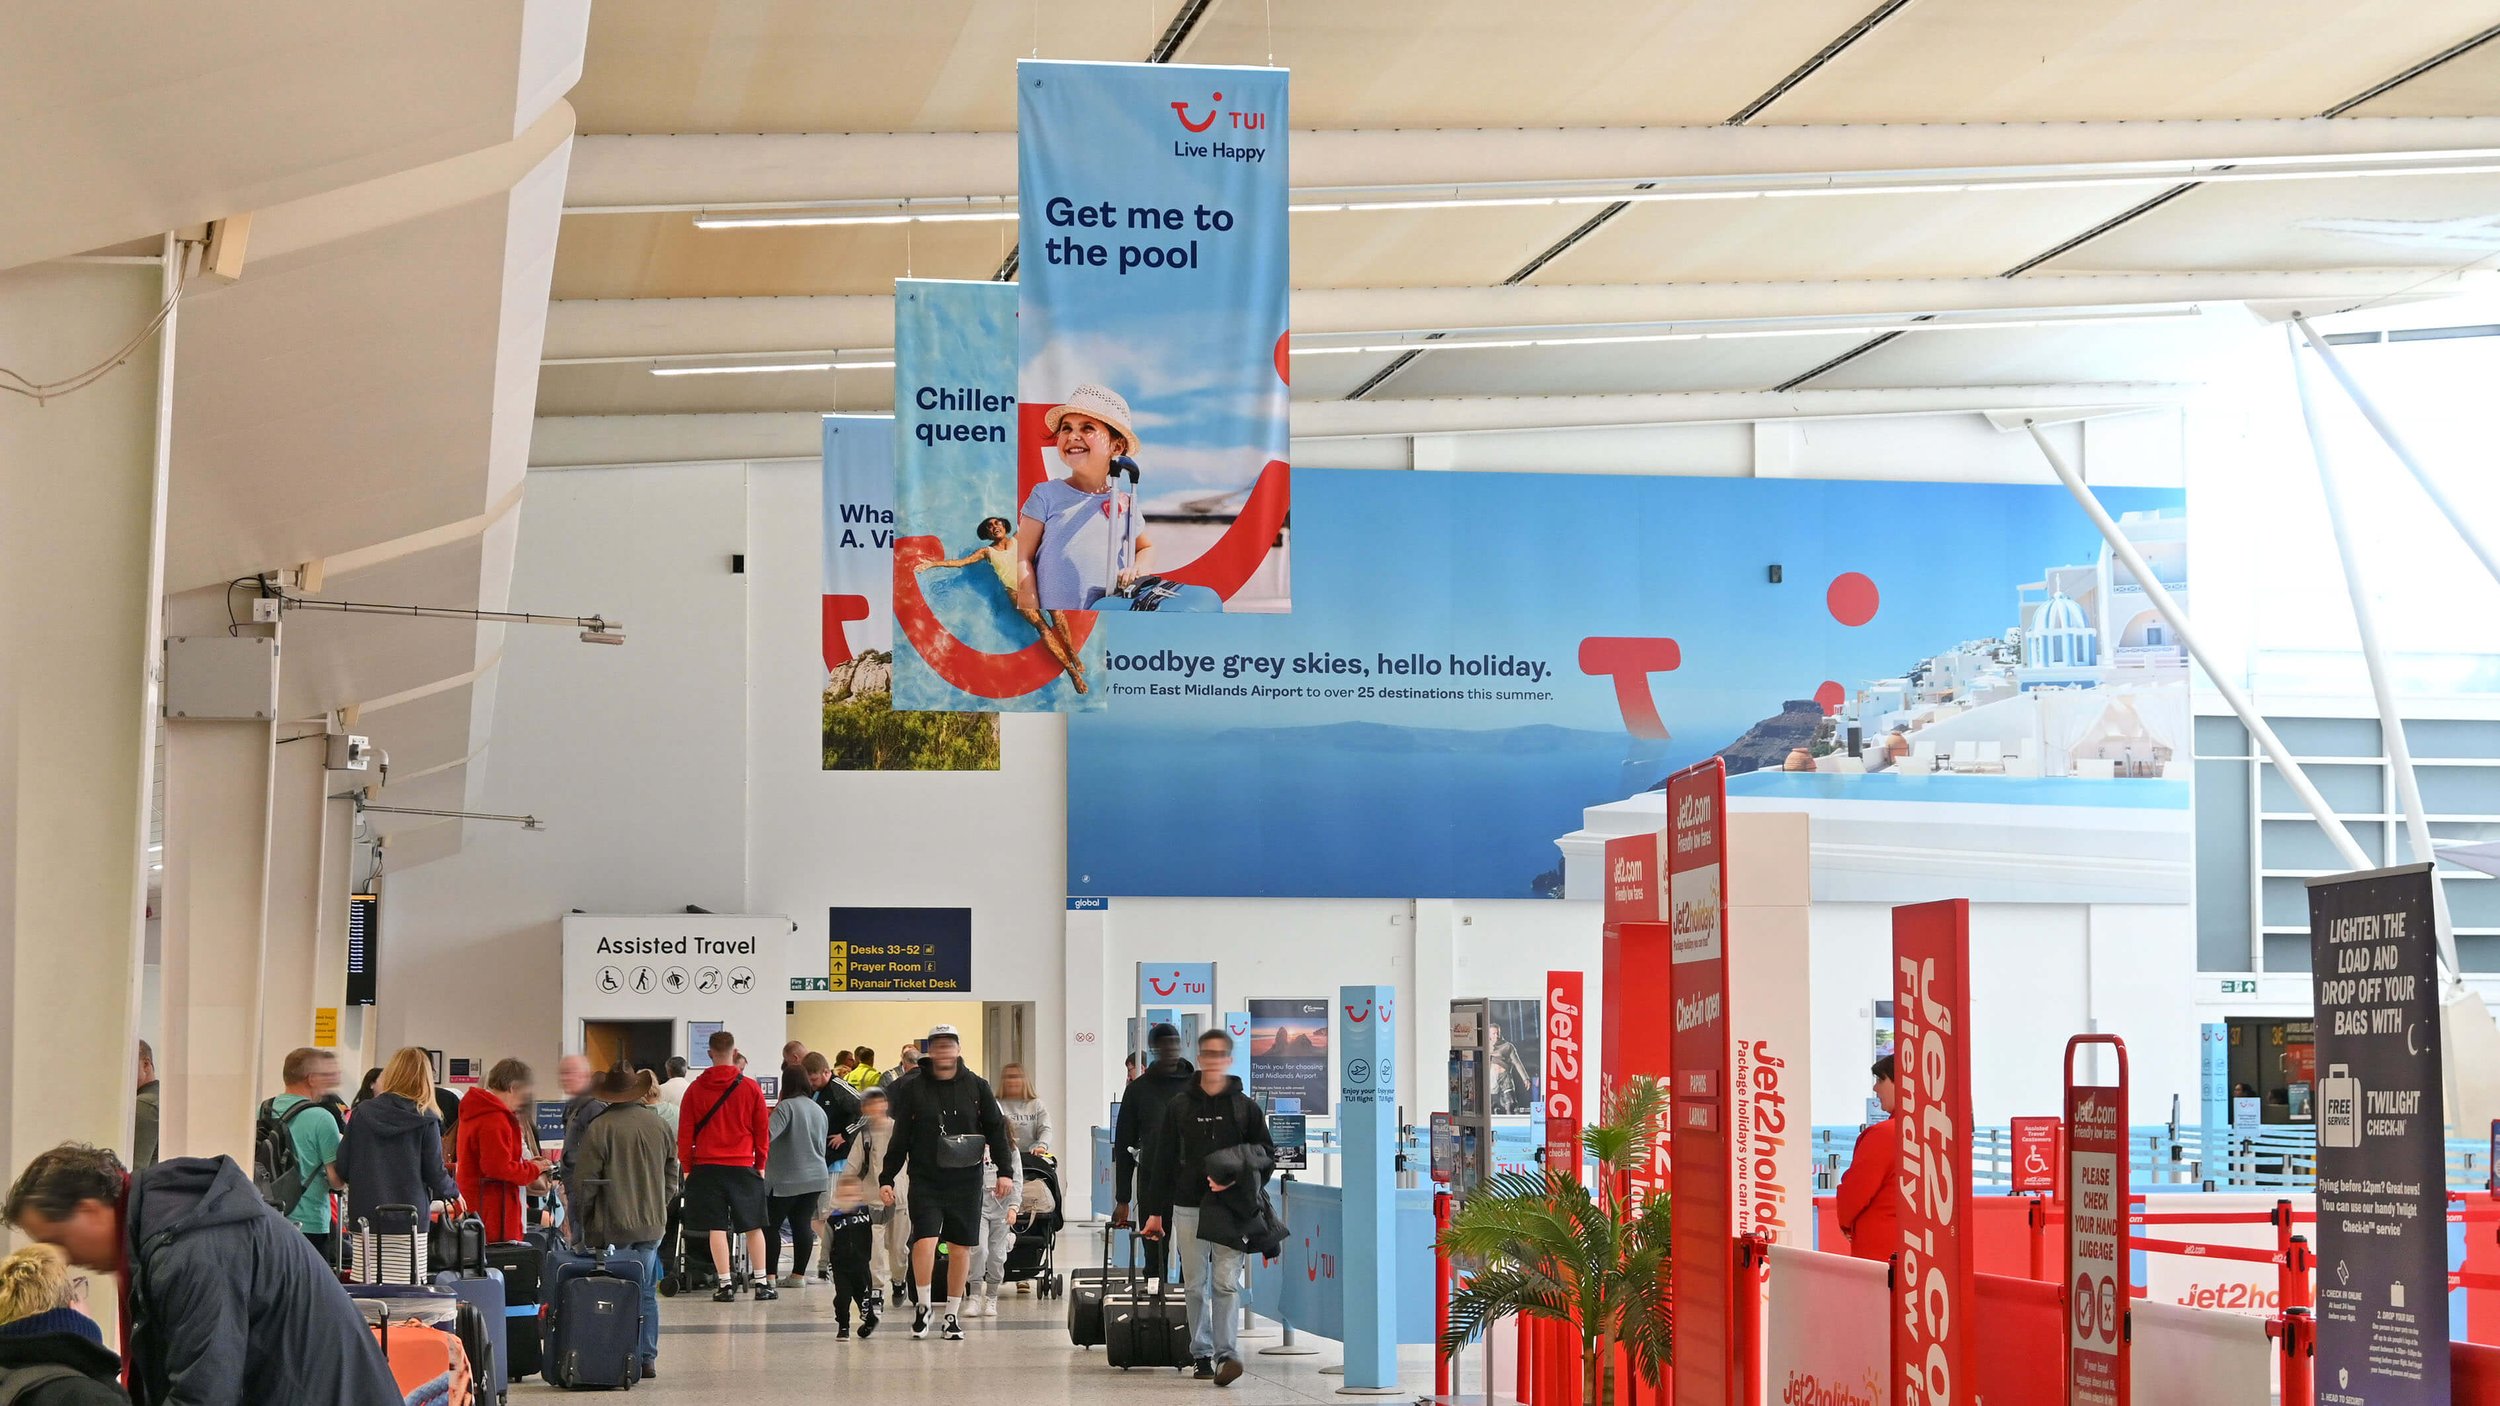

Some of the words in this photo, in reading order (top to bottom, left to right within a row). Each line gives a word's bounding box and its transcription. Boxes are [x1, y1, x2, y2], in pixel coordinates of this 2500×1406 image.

[1229, 112, 1266, 130] TUI
[1174, 141, 1208, 158] Live
[1212, 142, 1266, 163] Happy
[1045, 196, 1117, 229] Get
[1127, 205, 1184, 231] me
[1194, 204, 1235, 232] to
[1045, 236, 1108, 267] the
[1118, 240, 1199, 274] pool
[915, 386, 1016, 415] Chiller
[915, 422, 1006, 449] queen
[839, 529, 864, 550] A.
[1222, 653, 1286, 679] grey
[1291, 652, 1370, 678] skies,
[1377, 653, 1443, 678] hello
[1449, 654, 1552, 684] holiday.
[1112, 682, 1146, 696] from
[1149, 683, 1181, 697] East
[1184, 683, 1248, 698] Midlands
[1250, 684, 1303, 702] Airport
[1306, 687, 1320, 699] to
[1323, 689, 1354, 699] over
[1357, 686, 1375, 699] 25
[1378, 687, 1464, 700] destinations
[1467, 688, 1493, 701] this
[1495, 692, 1554, 702] summer.
[1676, 794, 1712, 830] Jet2.com
[1677, 832, 1694, 854] Friendly
[1694, 831, 1702, 849] low
[1702, 829, 1712, 846] fares
[1613, 858, 1643, 884] Jet2.com
[1074, 898, 1100, 909] global
[1614, 885, 1628, 903] Friendly
[2330, 915, 2380, 944] LIGHTEN
[2383, 912, 2407, 939] THE
[597, 936, 687, 955] Assisted
[694, 936, 756, 955] Travel
[850, 943, 884, 955] Desks
[886, 943, 920, 955] 33-52
[850, 961, 885, 974] Prayer
[888, 961, 921, 973] Room
[2338, 947, 2370, 974] LOAD
[2373, 945, 2399, 972] AND
[850, 978, 892, 991] Ryanair
[893, 978, 927, 989] Ticket
[929, 978, 957, 990] Desk
[1183, 982, 1205, 994] TUI
[2322, 980, 2356, 1006] DROP
[2358, 977, 2382, 1004] OFF
[2384, 975, 2416, 1002] YOUR
[1676, 992, 1704, 1033] Check-in
[1704, 991, 1721, 1029] open
[2334, 1010, 2368, 1036] BAGS
[2372, 1008, 2402, 1034] WITH
[2230, 1026, 2242, 1046] 37
[1295, 1063, 1324, 1071] choosing
[1735, 1040, 1749, 1096] Package
[1343, 1088, 1359, 1096] Enjoy
[1360, 1088, 1376, 1096] your
[1899, 955, 1919, 1213] Friendly
[1357, 1096, 1374, 1104] flight
[2327, 1099, 2351, 1115] FREE
[2367, 1090, 2421, 1115] TWILIGHT
[2074, 1100, 2117, 1124] Jet2.com
[2327, 1116, 2351, 1126] SERVICE
[1736, 1098, 1749, 1154] holidays
[2074, 1124, 2094, 1141] Friendly
[2103, 1126, 2117, 1140] fares
[1736, 1156, 1748, 1177] you
[2081, 1166, 2111, 1187] PLEASE
[1738, 1179, 1748, 1206] can
[2319, 1178, 2340, 1195] Flying
[2340, 1179, 2362, 1194] before
[2362, 1180, 2386, 1196] 12pm?
[2386, 1181, 2404, 1196] Great
[2404, 1182, 2421, 1196] news!
[2083, 1191, 2109, 1212] CHECK
[2322, 1199, 2335, 1213] You
[2336, 1202, 2350, 1213] can
[2350, 1203, 2362, 1214] use
[2362, 1203, 2374, 1214] our
[2374, 1202, 2396, 1217] handy
[2396, 1202, 2418, 1219] Twilight
[2074, 1214, 2094, 1235] YOUR
[2095, 1216, 2118, 1238] HAND
[2078, 1239, 2115, 1262] LUGGAGE
[1321, 1252, 1335, 1280] TUI
[1902, 1228, 1924, 1344] low
